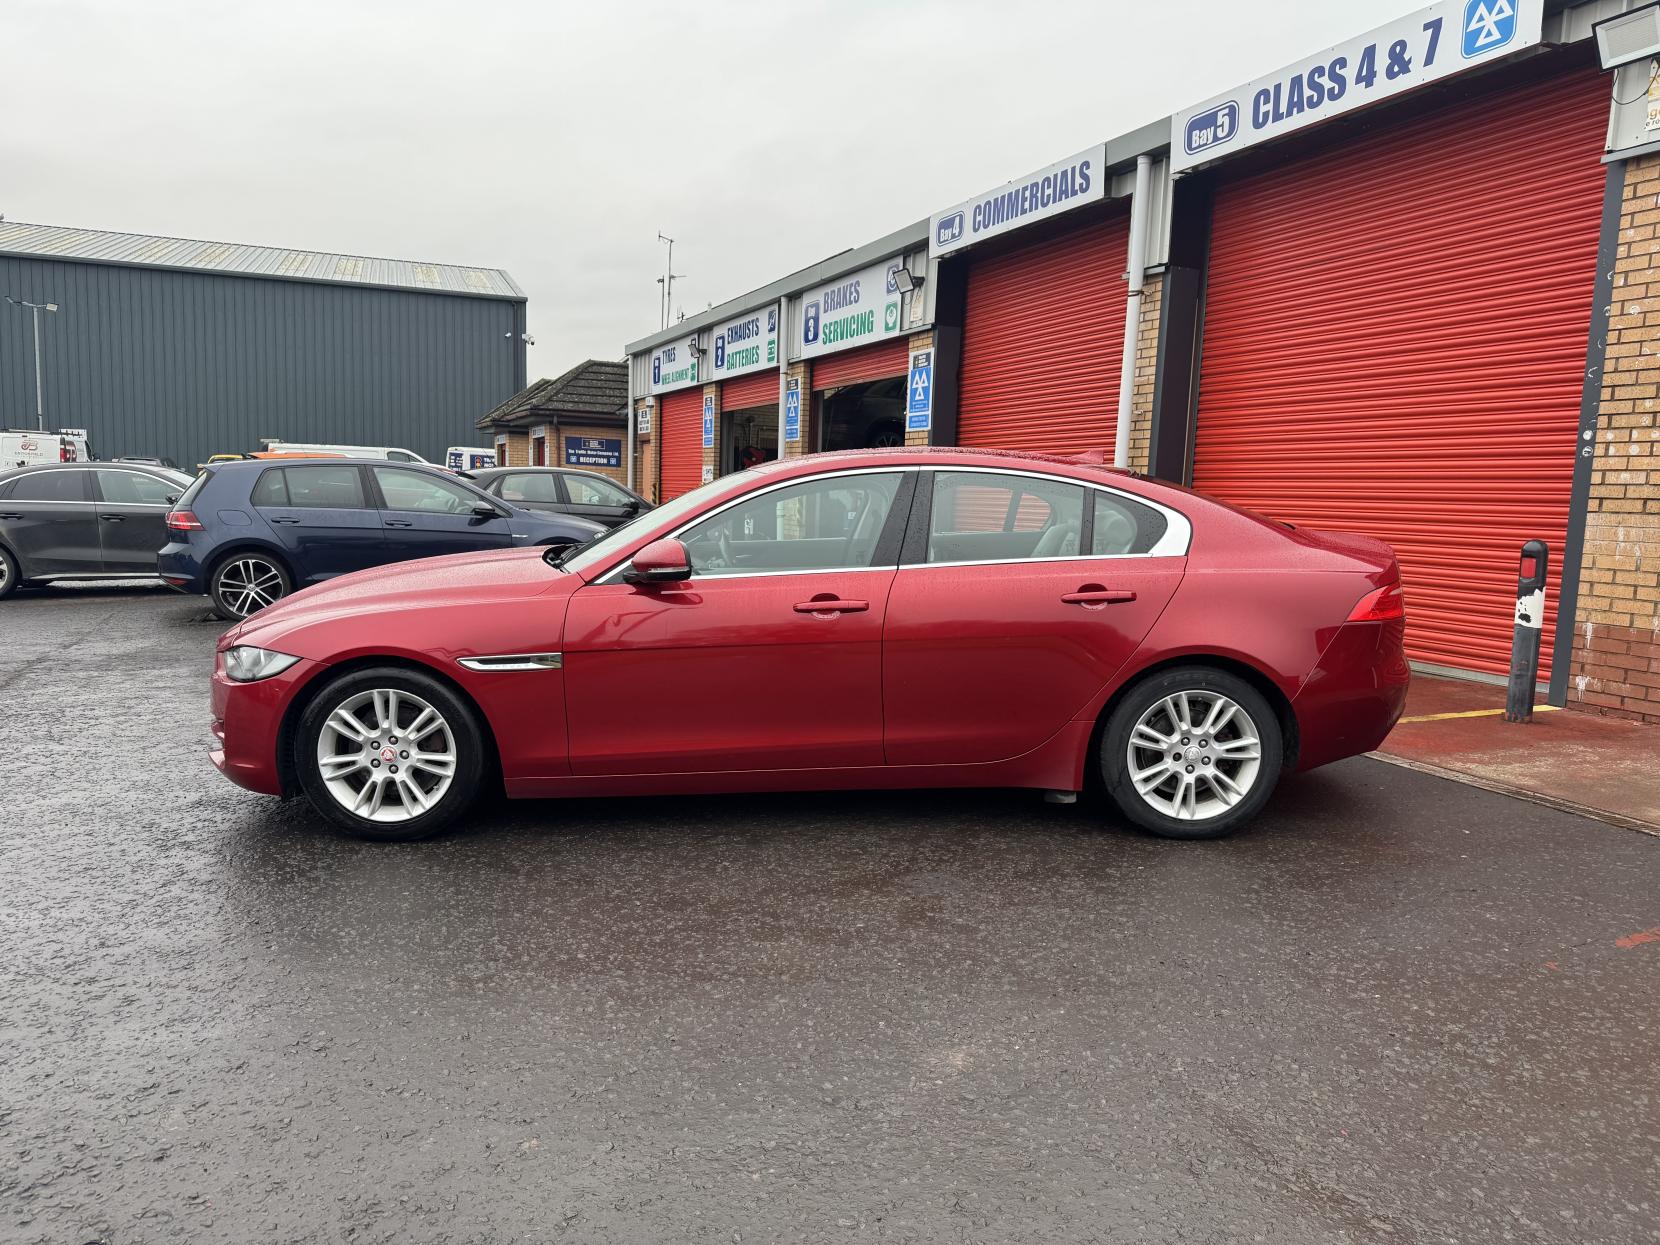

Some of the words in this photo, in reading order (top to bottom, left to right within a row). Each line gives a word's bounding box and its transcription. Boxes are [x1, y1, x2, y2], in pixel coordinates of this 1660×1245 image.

[1252, 57, 1347, 130] CLASS
[1354, 43, 1377, 89] 4
[1385, 39, 1412, 81] &
[1422, 16, 1443, 68] 7
[1191, 125, 1215, 149] Bay
[1216, 109, 1230, 139] 5
[972, 160, 1091, 233] COMMERCIALS
[940, 226, 952, 242] Bay
[952, 215, 960, 237] 4
[823, 280, 860, 314] BRAKES
[727, 317, 760, 345] EXHAUSTS
[808, 319, 815, 341] 3
[822, 309, 875, 345] SERVICING
[662, 346, 676, 365] TYRES
[717, 348, 722, 366] 2
[727, 345, 760, 371] BATTERIES
[655, 367, 659, 383] 1
[579, 456, 608, 464] RECEPTION
